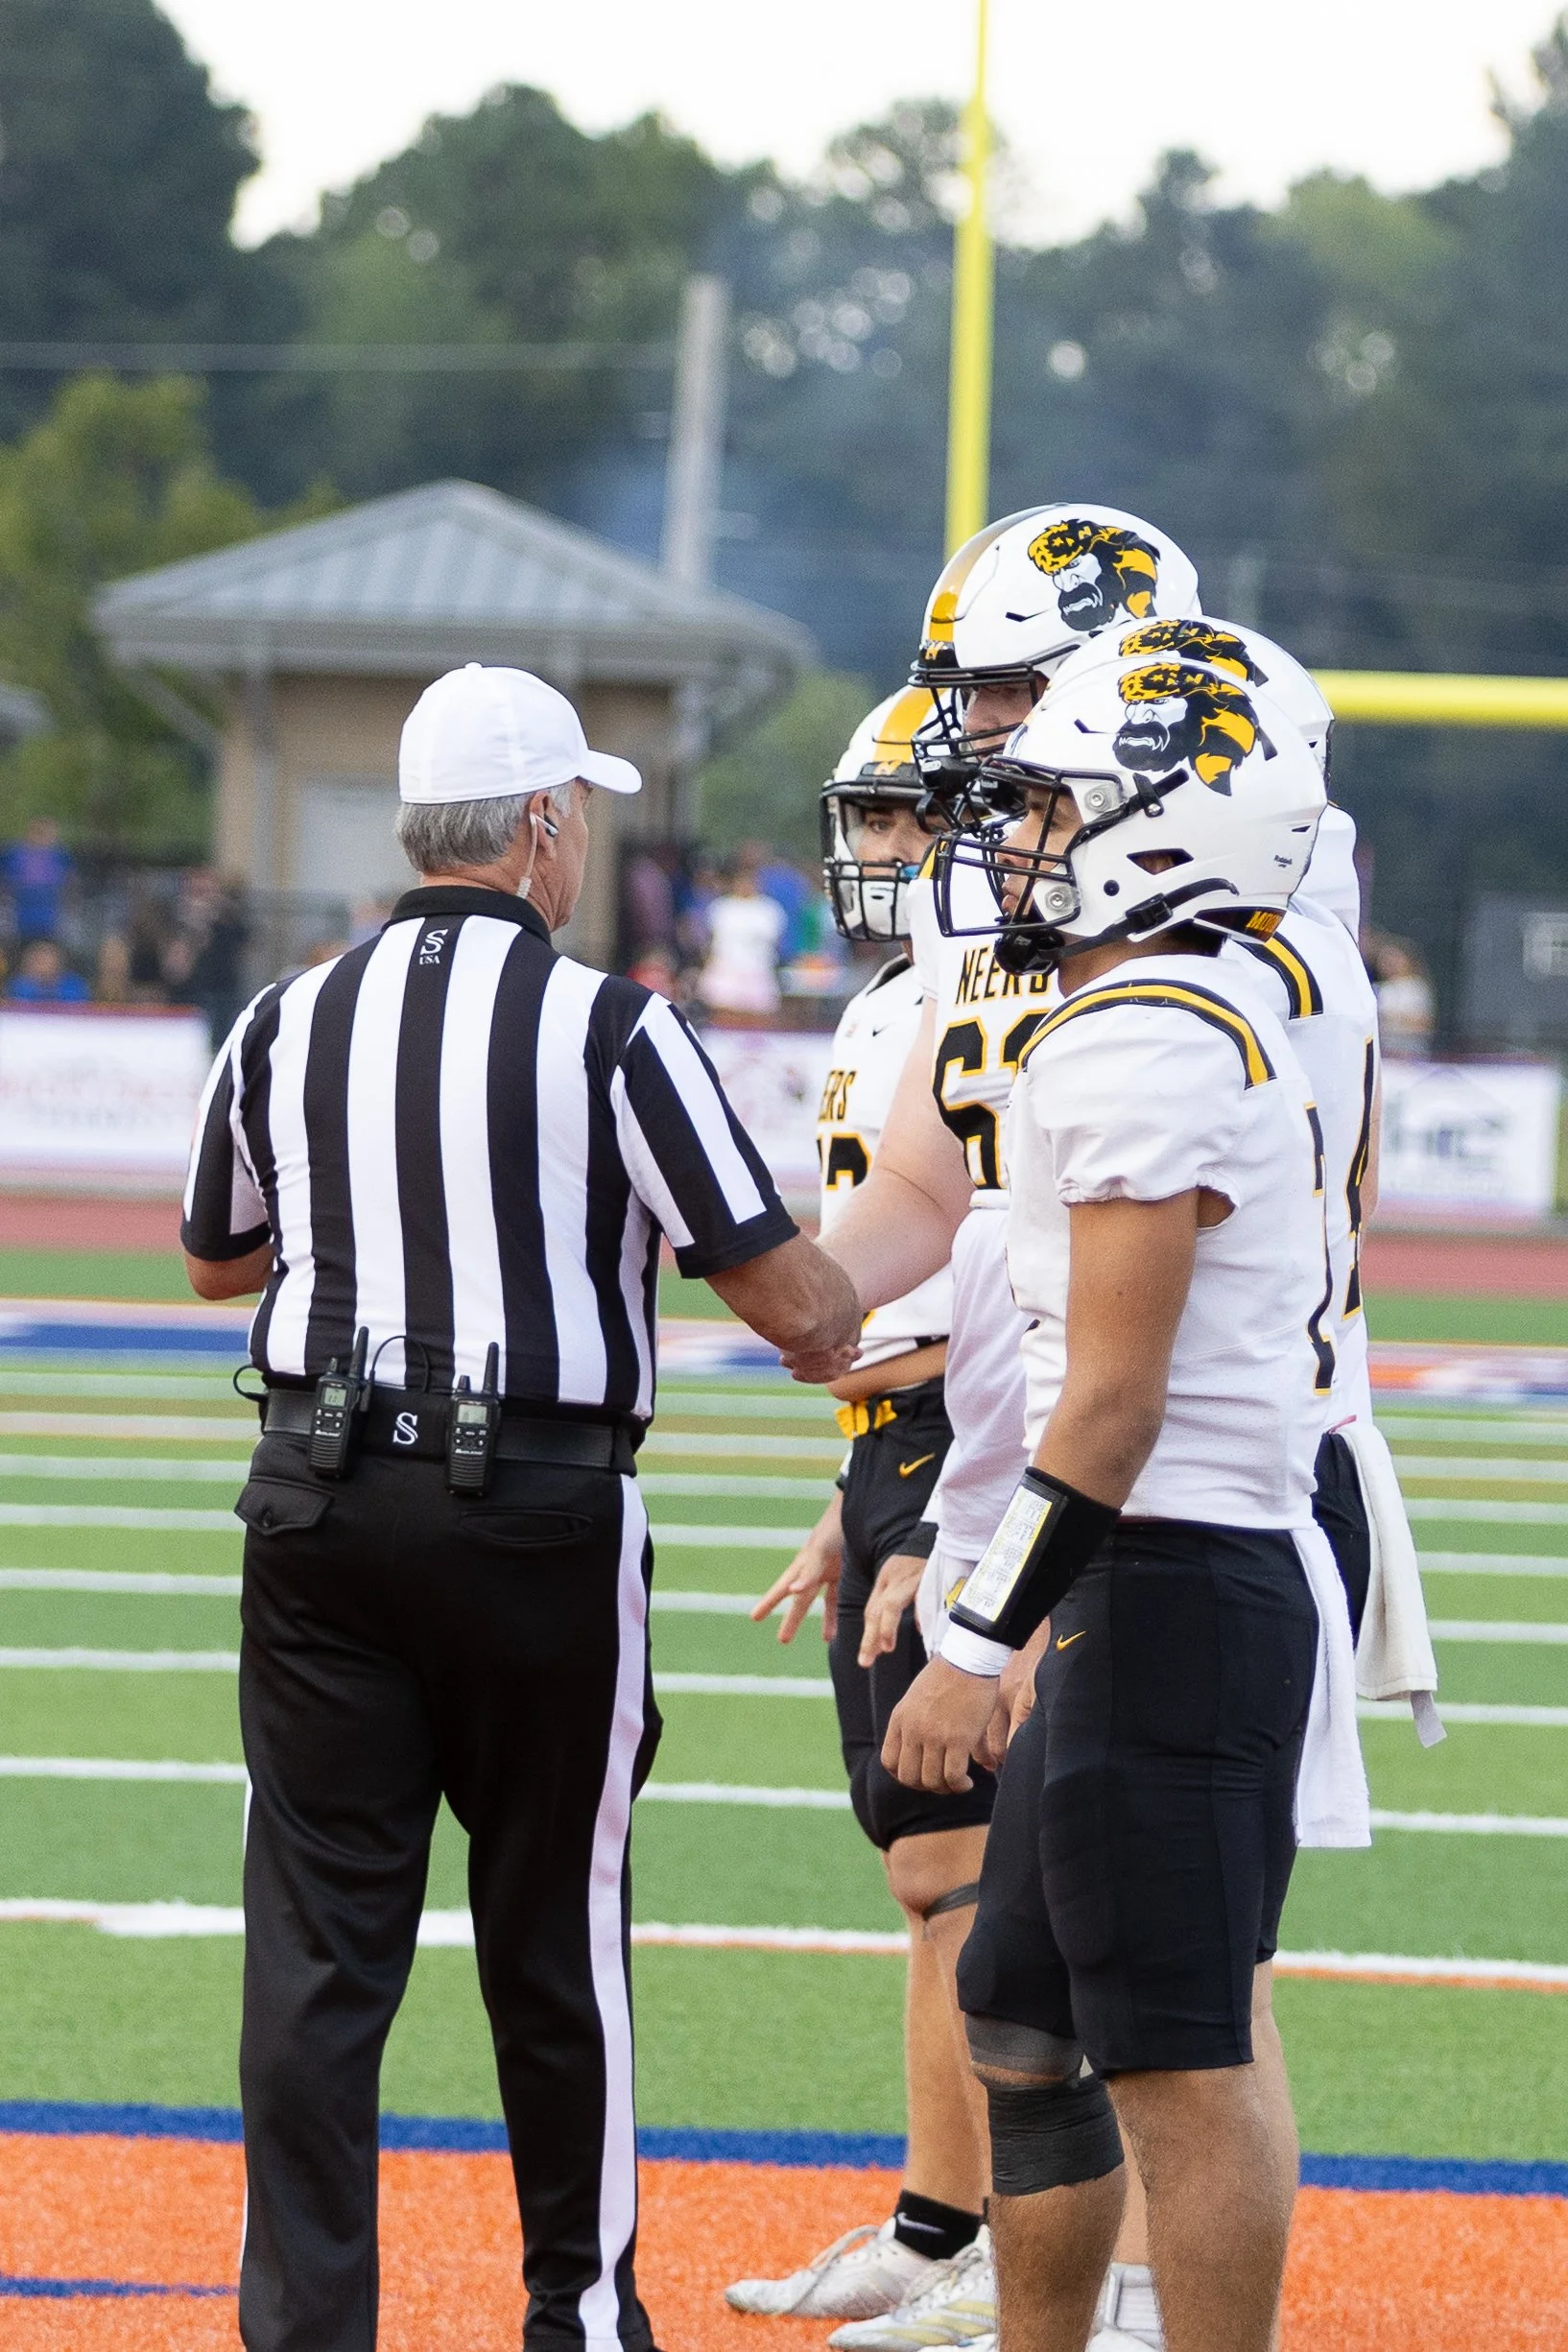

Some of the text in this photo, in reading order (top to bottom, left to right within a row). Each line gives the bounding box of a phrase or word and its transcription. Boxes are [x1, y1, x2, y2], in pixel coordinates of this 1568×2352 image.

[419, 928, 449, 955] S
[418, 955, 440, 965] USA
[392, 1412, 418, 1445] S
